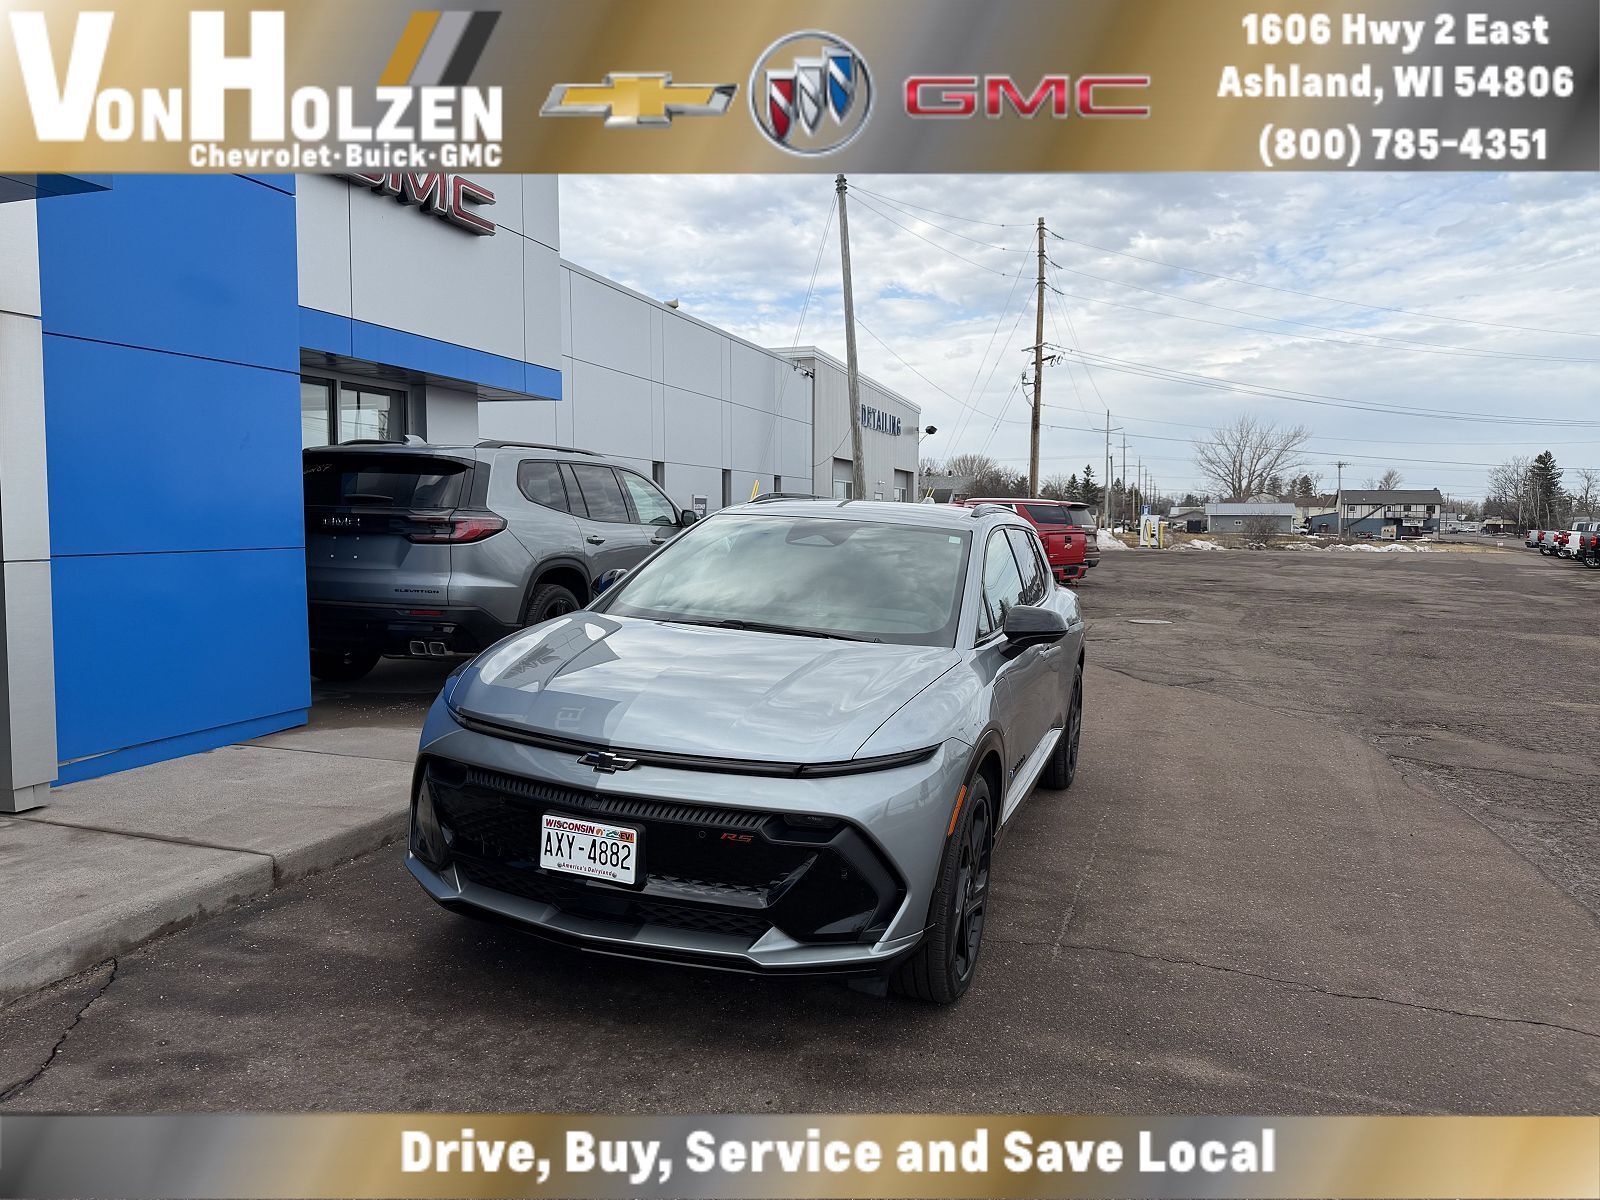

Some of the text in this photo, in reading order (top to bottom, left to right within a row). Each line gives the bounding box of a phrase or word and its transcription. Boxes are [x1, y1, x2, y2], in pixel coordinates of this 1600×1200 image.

[354, 173, 496, 236] MC
[861, 404, 901, 436] DETAILING
[545, 818, 595, 835] WISCONSIN
[720, 833, 754, 842] RS
[544, 831, 631, 870] AXY-4882
[561, 862, 613, 876] America's Dairyland
